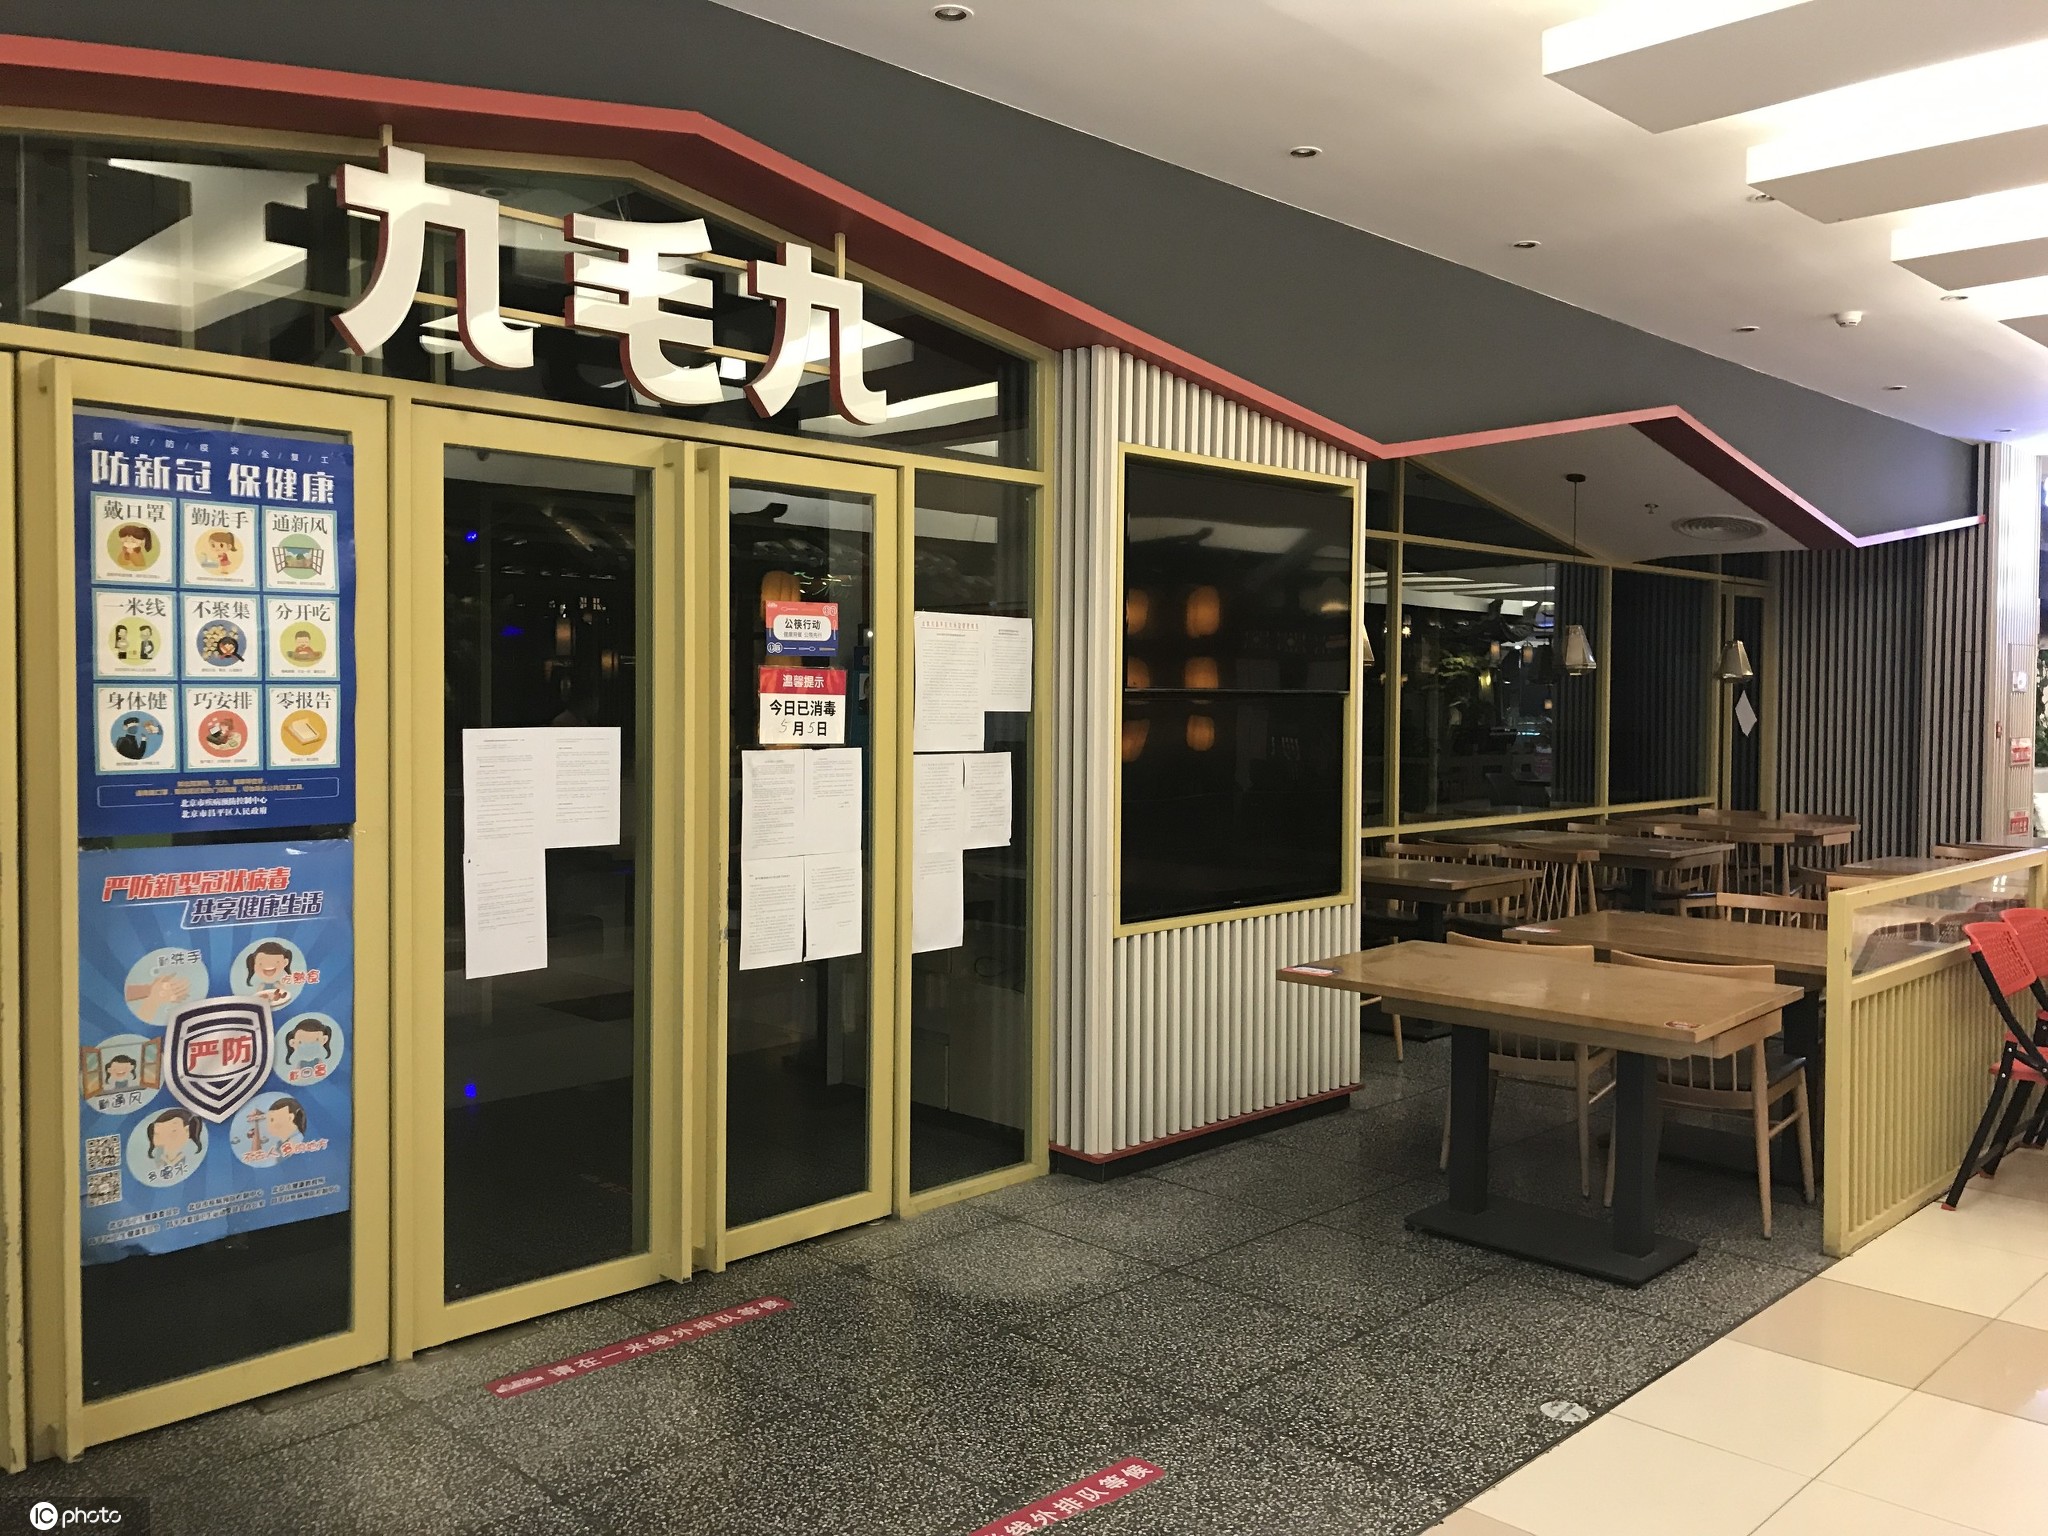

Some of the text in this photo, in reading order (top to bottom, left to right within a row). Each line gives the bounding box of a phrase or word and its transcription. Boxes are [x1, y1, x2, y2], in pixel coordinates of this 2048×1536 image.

[330, 145, 887, 426] 九毛九
[91, 449, 335, 505] 防新冠 保健康
[104, 500, 166, 523] 戴口罩
[191, 507, 249, 529] 勤洗手
[271, 514, 328, 535] 通新风
[103, 597, 167, 617] 一米线
[193, 600, 250, 619] 不聚集
[277, 603, 331, 622] 分开吃
[784, 618, 821, 631] 公筷行动
[783, 674, 824, 688] 温馨提示
[106, 691, 168, 711] 身体健
[193, 691, 253, 710] 巧安排
[276, 691, 332, 710] 零报告
[769, 699, 837, 717] 今日已消毒
[180, 806, 268, 819] 北京市昌平区人民政府
[102, 867, 291, 902] 严防新型冠状病毒
[190, 891, 324, 924] 共享健康生活
[188, 1035, 252, 1072] 严防
[547, 1299, 785, 1377] 请在一米线外排队等候
[985, 1463, 1154, 1536] 线外排队等候
